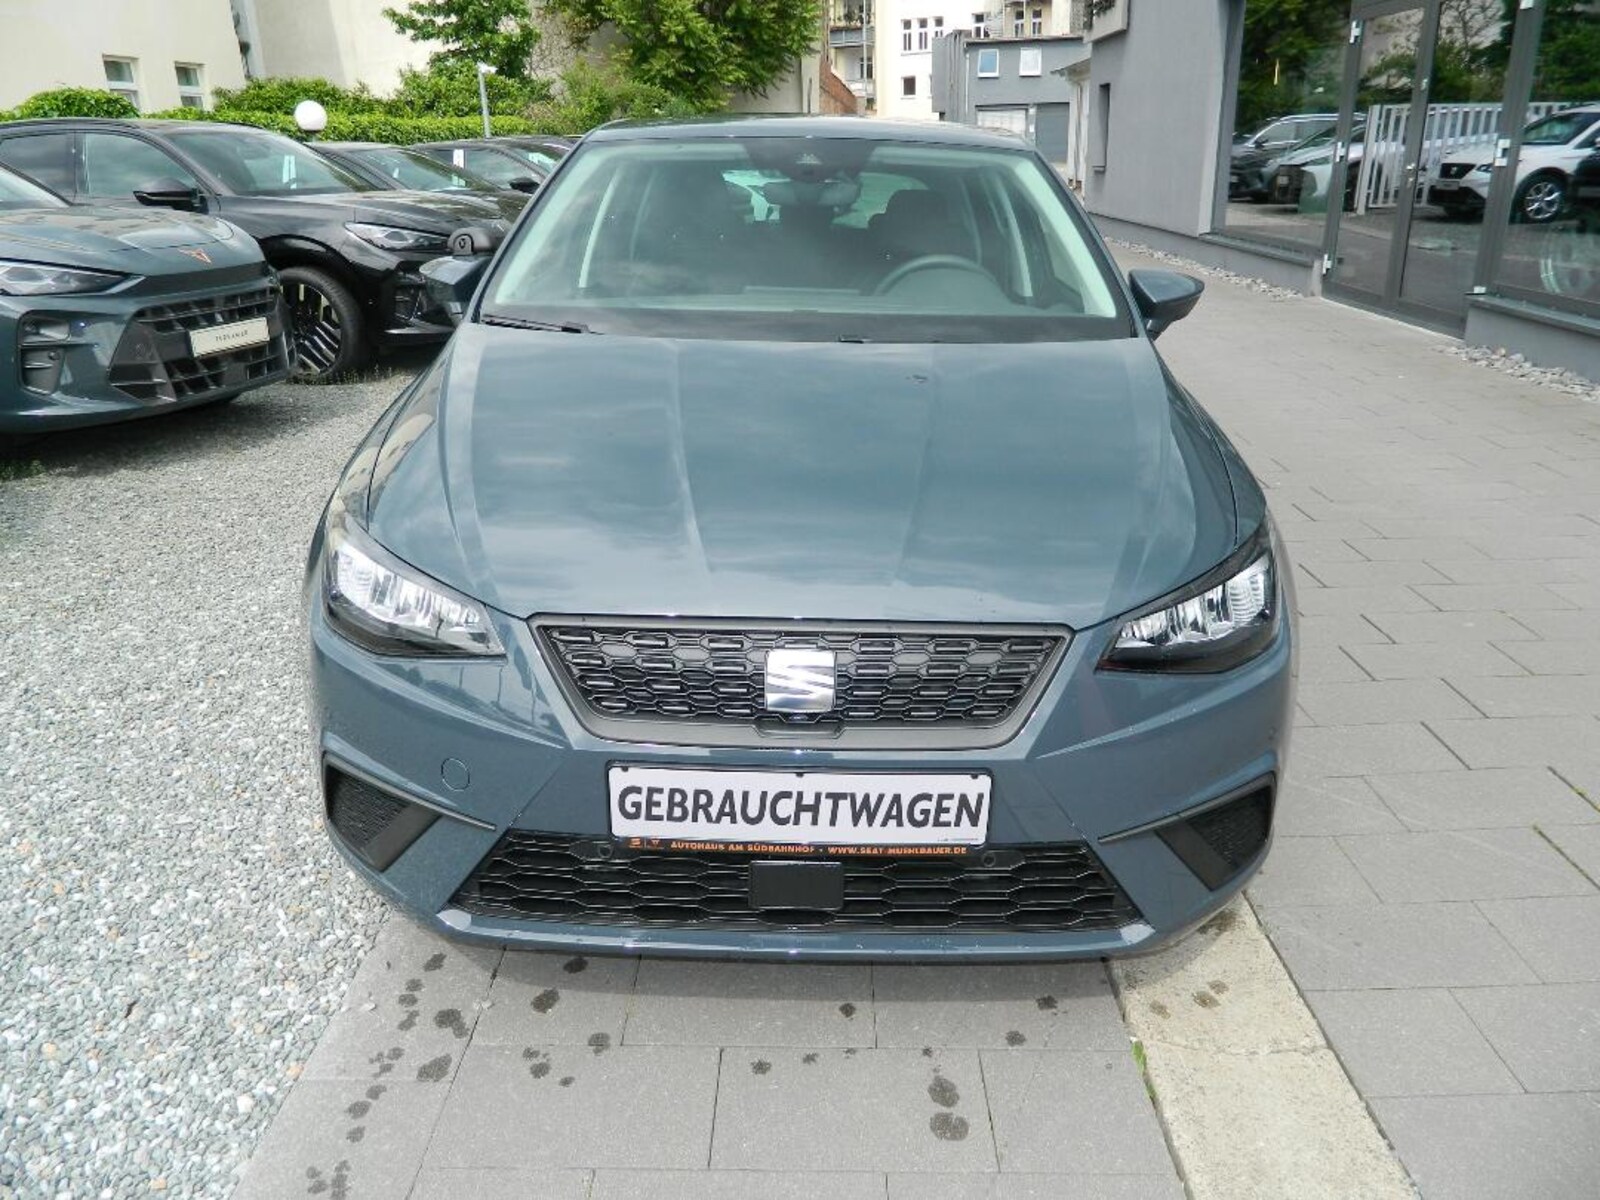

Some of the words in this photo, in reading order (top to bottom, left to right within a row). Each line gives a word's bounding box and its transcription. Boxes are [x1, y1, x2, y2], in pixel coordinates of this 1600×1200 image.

[618, 785, 984, 828] GEBRAUCHTWAGEN
[670, 840, 725, 850] AUTOHAUS
[728, 843, 744, 851] AM
